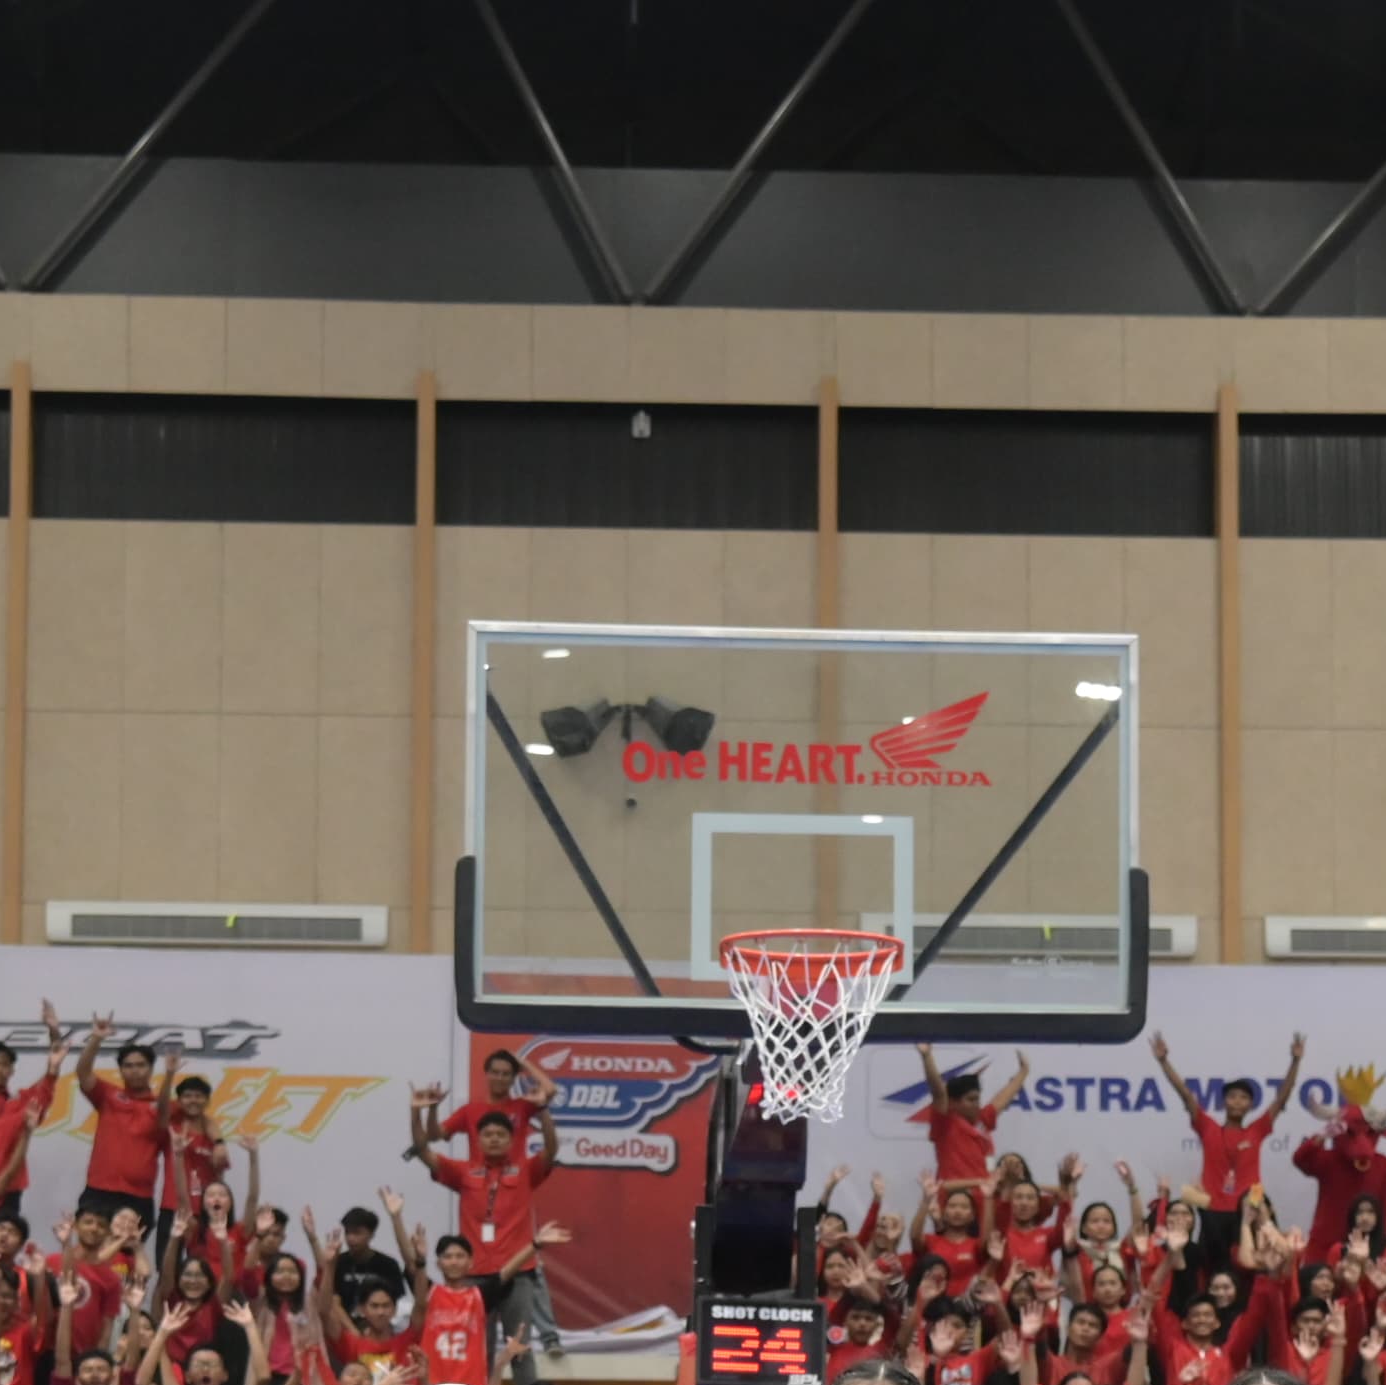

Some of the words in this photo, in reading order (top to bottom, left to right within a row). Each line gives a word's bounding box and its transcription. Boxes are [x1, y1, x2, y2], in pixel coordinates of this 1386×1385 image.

[623, 741, 706, 783] One
[718, 742, 865, 784] HEART.
[872, 769, 991, 787] HONDA
[570, 1055, 676, 1073] HONDA
[568, 1083, 621, 1109] DBL
[1007, 1077, 1167, 1113] ASTRA
[575, 1137, 627, 1158] Good
[630, 1138, 669, 1164] Day
[711, 1304, 756, 1320] SHOT
[759, 1307, 814, 1322] CLOCK
[435, 1331, 467, 1361] 42
[713, 1326, 807, 1375] 24
